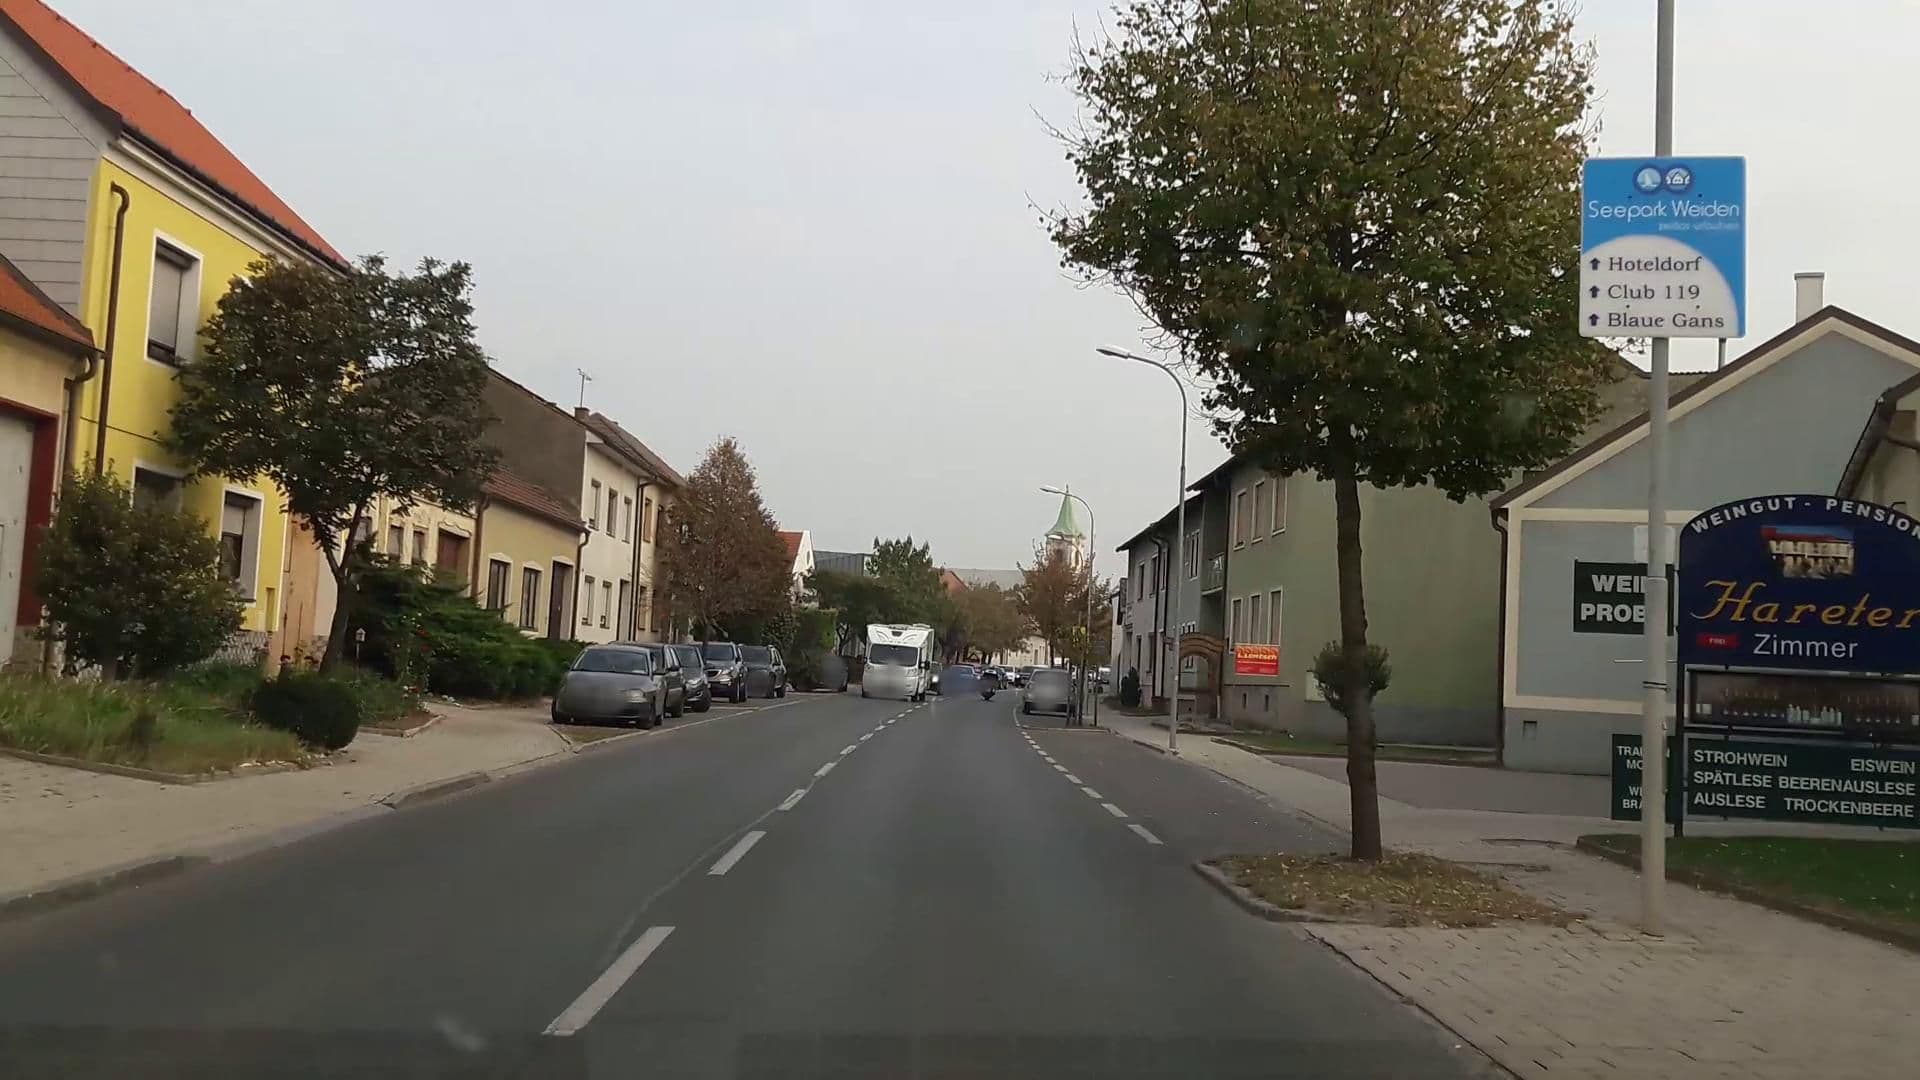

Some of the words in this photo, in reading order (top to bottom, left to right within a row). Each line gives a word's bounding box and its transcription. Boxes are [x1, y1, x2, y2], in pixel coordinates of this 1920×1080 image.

[1588, 200, 1667, 222] Seepark
[1672, 200, 1740, 217] Weiden
[1608, 256, 1703, 271] Hoteldorf
[1607, 284, 1656, 299] Club
[1665, 285, 1700, 299] 119
[1607, 313, 1665, 328] Blaue
[1672, 313, 1725, 328] Gans
[1691, 497, 1797, 534] WEINGUT
[1690, 580, 1920, 629] Hareter
[1753, 633, 1858, 659] Zimmer
[1693, 750, 1788, 768] STROHWEIN
[1850, 758, 1916, 775] EISWEIN
[1693, 769, 1773, 788] SPÄTLESE
[1778, 775, 1916, 796] BEERENAUSLESE
[1693, 792, 1767, 809] AUSLESE
[1783, 797, 1915, 818] TROCKENBEERE
